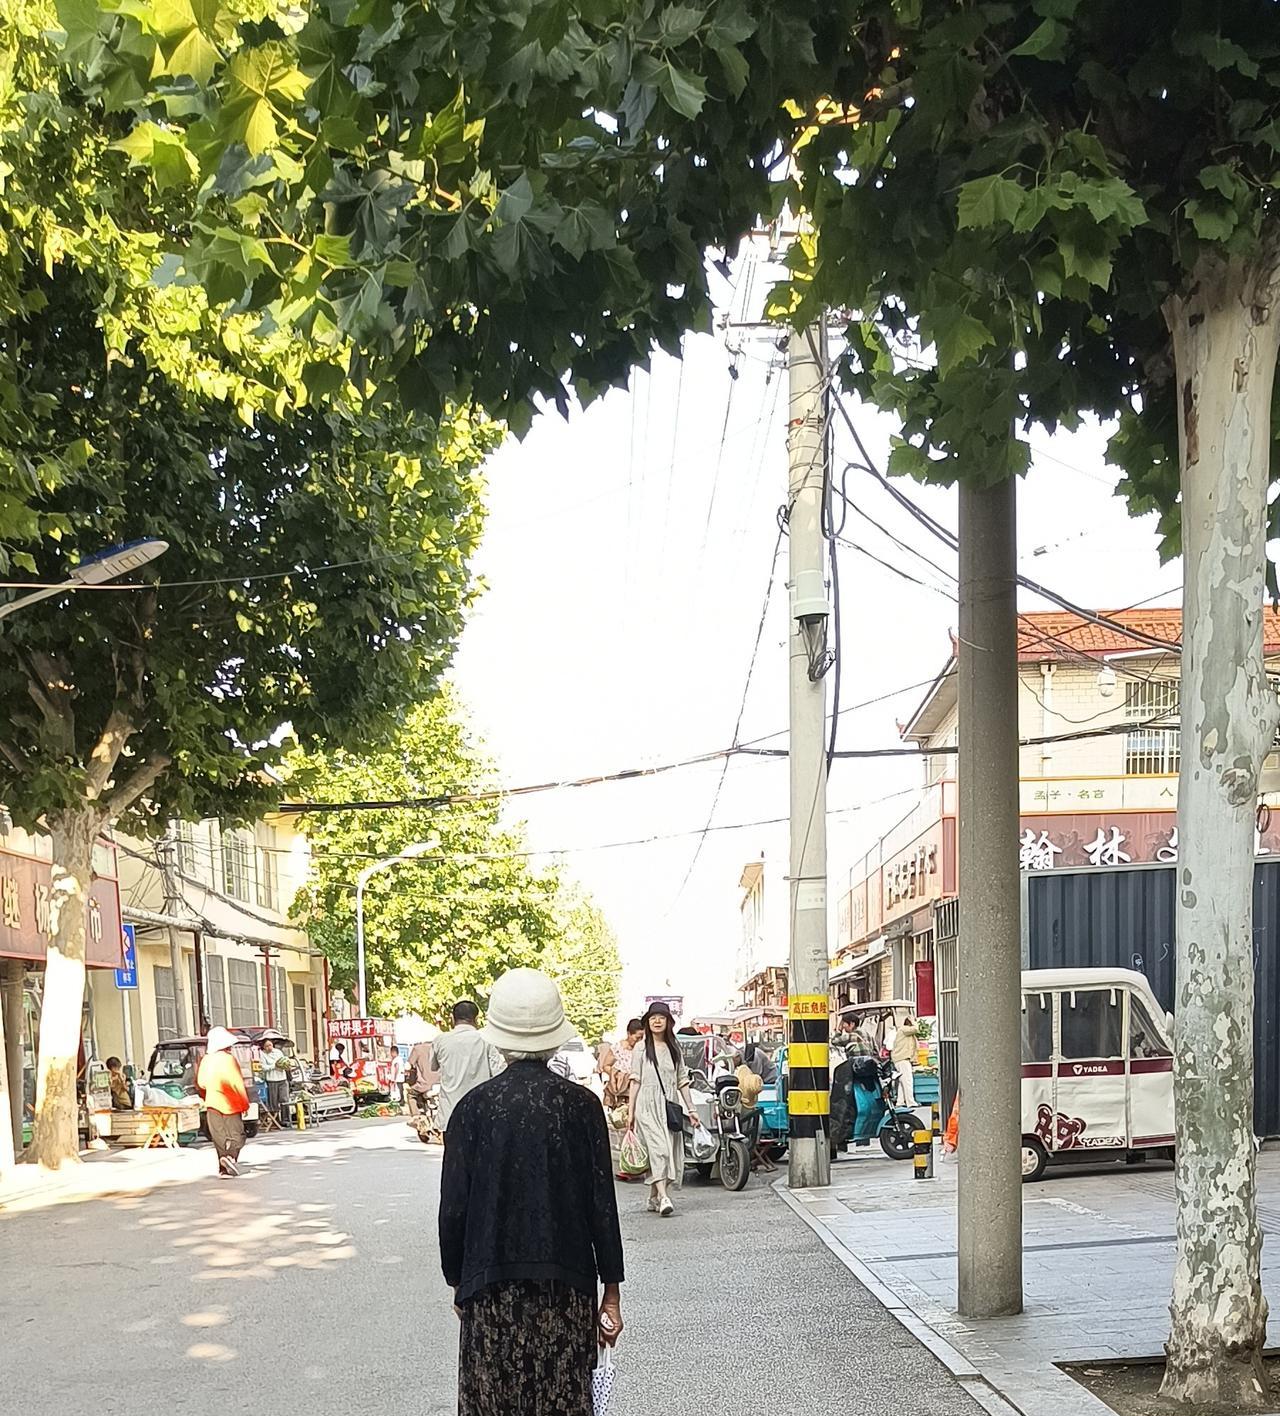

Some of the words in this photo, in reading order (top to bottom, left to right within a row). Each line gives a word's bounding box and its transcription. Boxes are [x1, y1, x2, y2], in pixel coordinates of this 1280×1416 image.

[793, 1001, 827, 1014] 高压危险
[328, 1019, 374, 1037] 煎饼果子
[1083, 1065, 1108, 1073] YADEA
